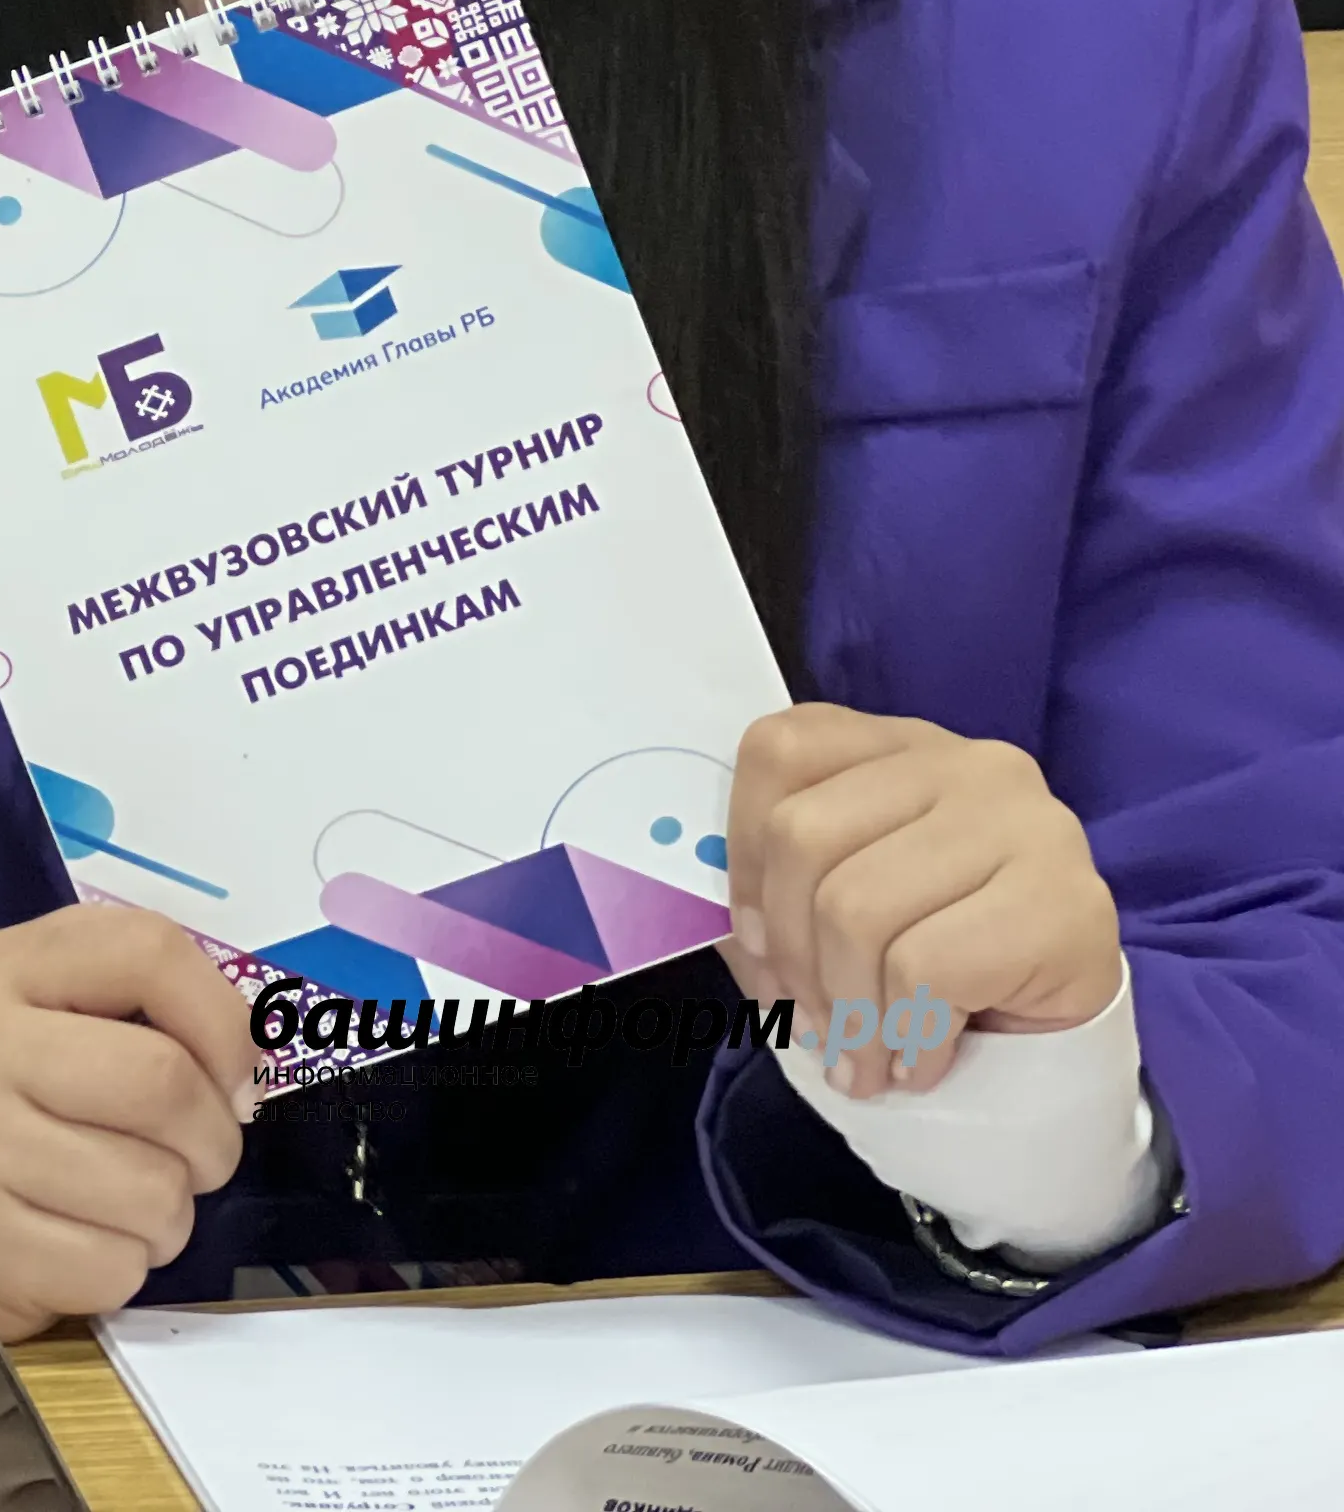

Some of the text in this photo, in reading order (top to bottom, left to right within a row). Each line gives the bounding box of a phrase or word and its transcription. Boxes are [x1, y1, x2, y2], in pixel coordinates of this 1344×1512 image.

[261, 304, 497, 410] Академия Главы РБ
[67, 413, 604, 636] МЕЖВУЗОВСКИЙ ТУРНИР
[118, 483, 601, 682] ПО УПРАВЛЕНЧЕСКИМ
[241, 579, 522, 705] ПОЕДИНКАМ
[689, 1449, 763, 1473] Романа,
